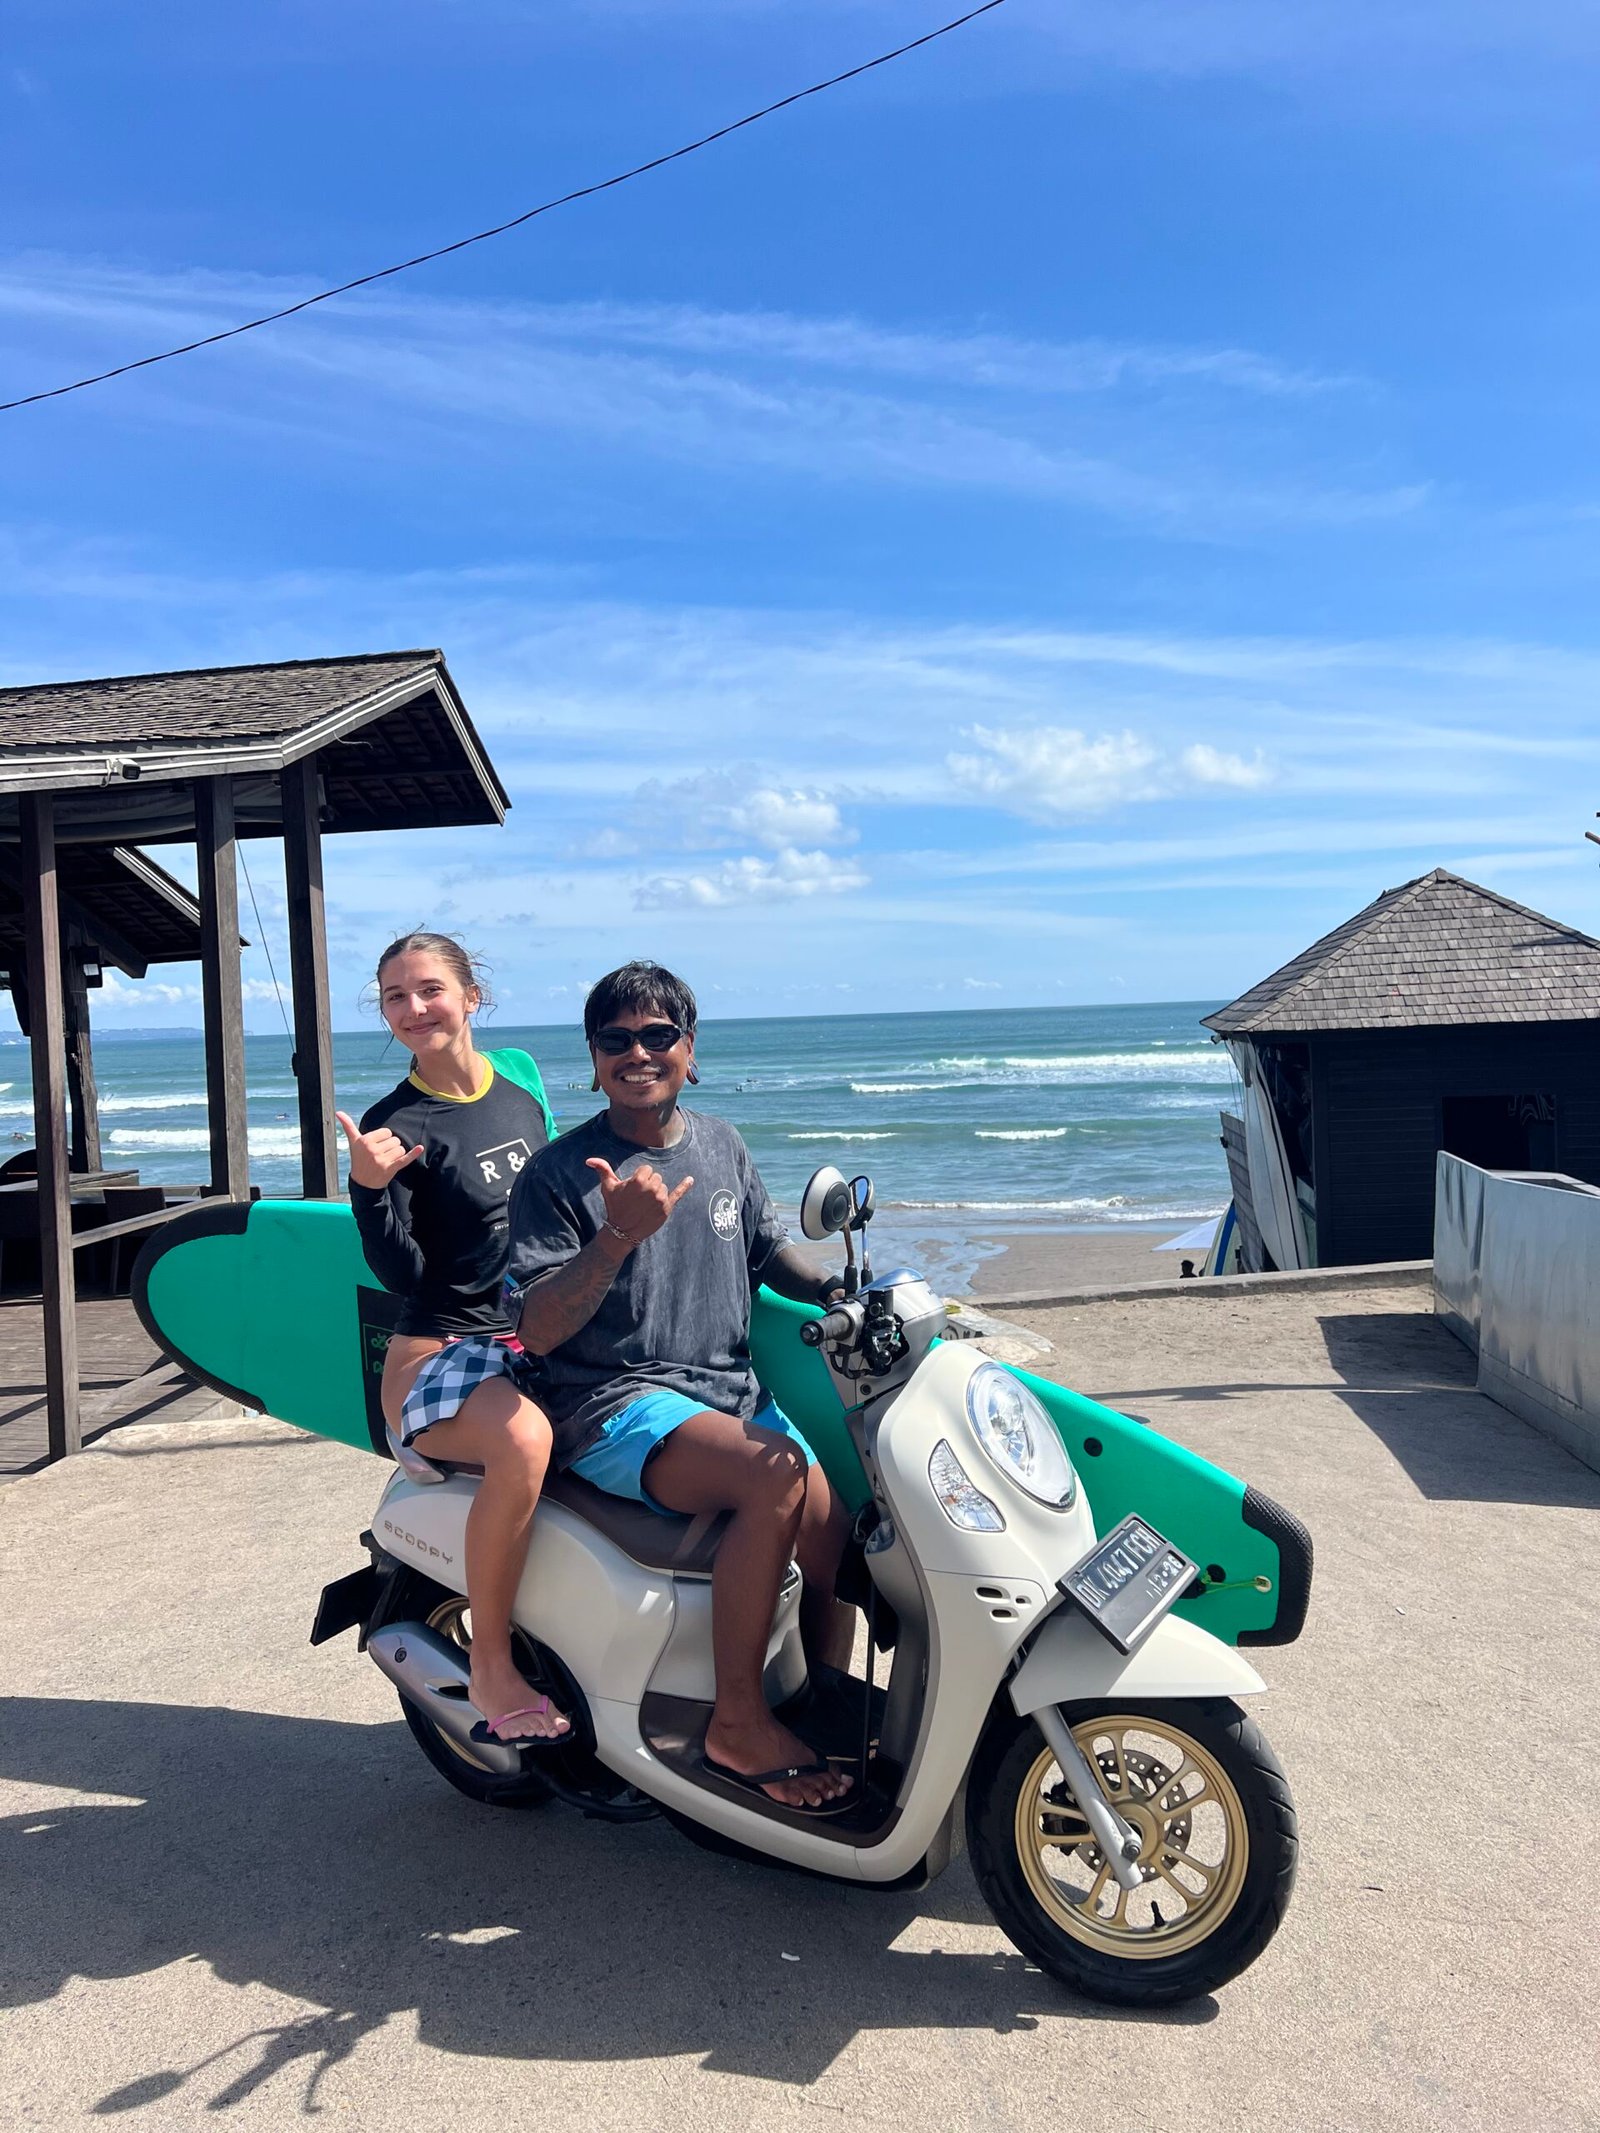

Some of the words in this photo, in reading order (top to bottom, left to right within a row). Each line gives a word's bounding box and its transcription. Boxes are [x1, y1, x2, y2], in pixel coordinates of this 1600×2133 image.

[480, 1160, 502, 1184] R
[507, 1151, 527, 1173] &
[713, 1209, 738, 1228] SURF
[384, 1520, 454, 1565] SCOOPY
[1076, 1575, 1111, 1609] DK
[1123, 1526, 1161, 1562] FCH
